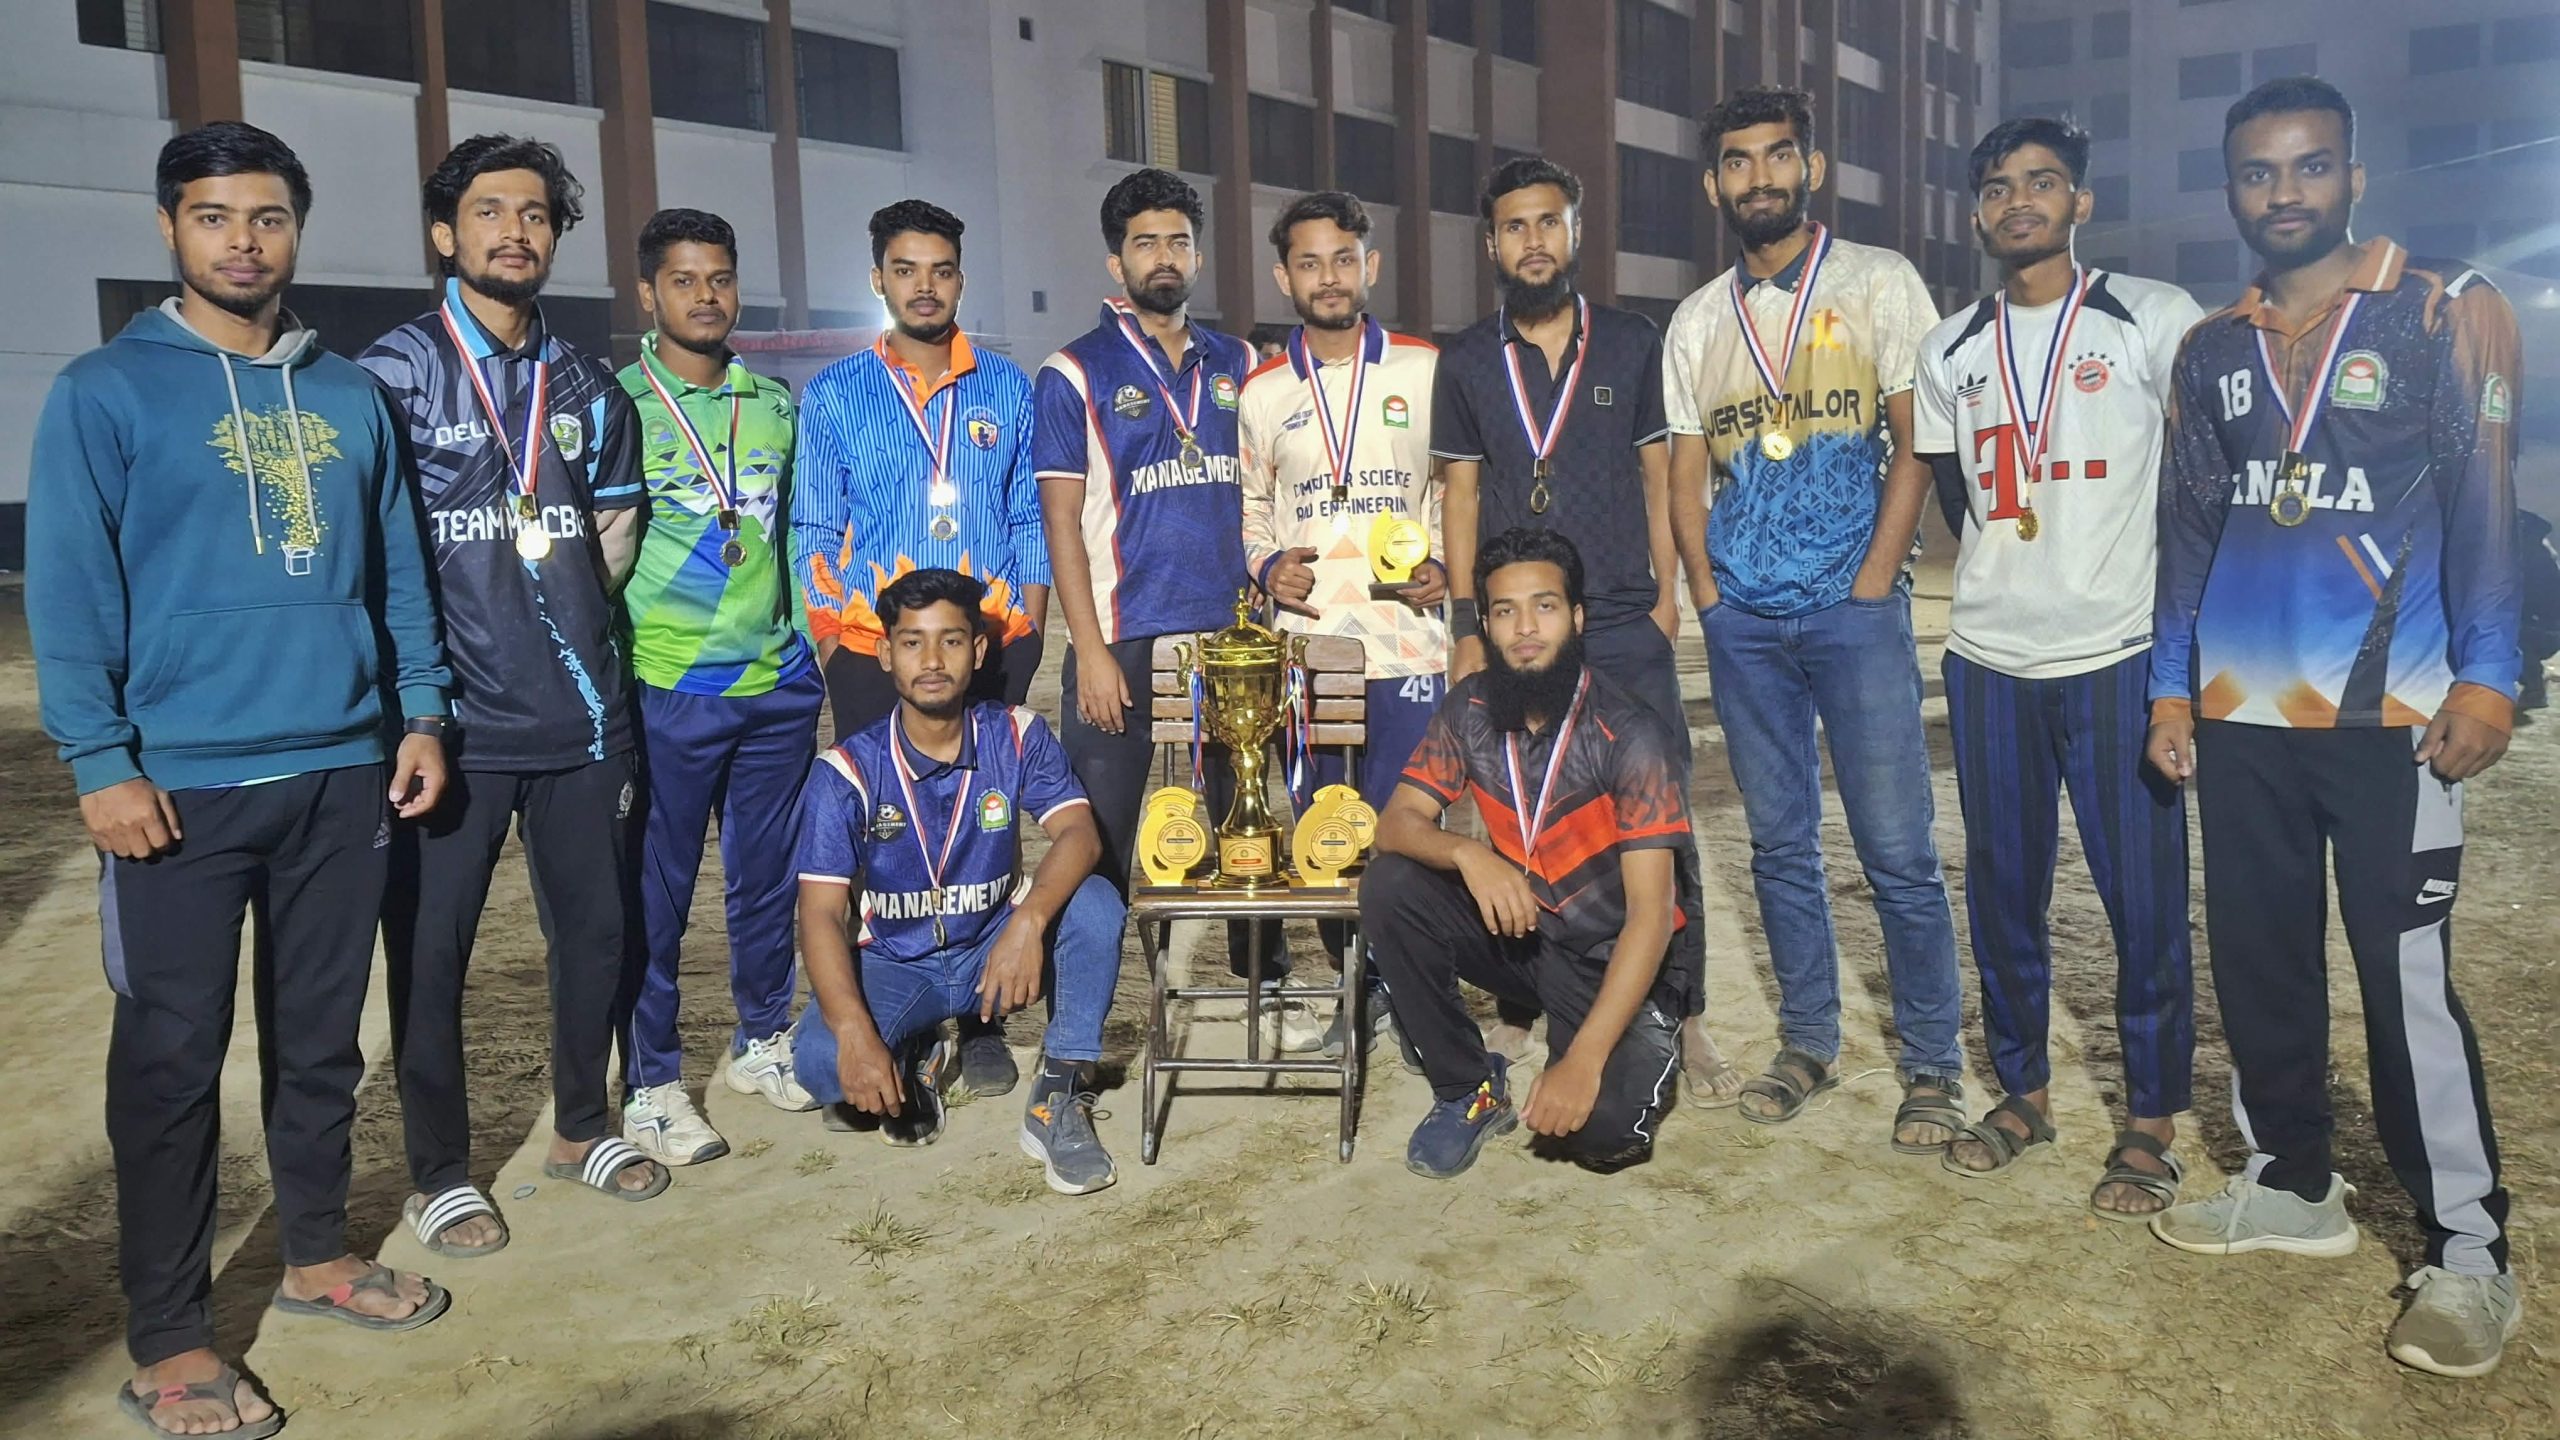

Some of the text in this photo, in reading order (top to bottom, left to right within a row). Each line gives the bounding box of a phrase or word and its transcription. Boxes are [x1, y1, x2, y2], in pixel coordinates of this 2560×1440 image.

[1781, 389, 1862, 429] TAILOR
[2218, 368, 2253, 421] 18
[1399, 674, 1433, 702] 49
[869, 874, 1011, 919] MANAGEMENT
